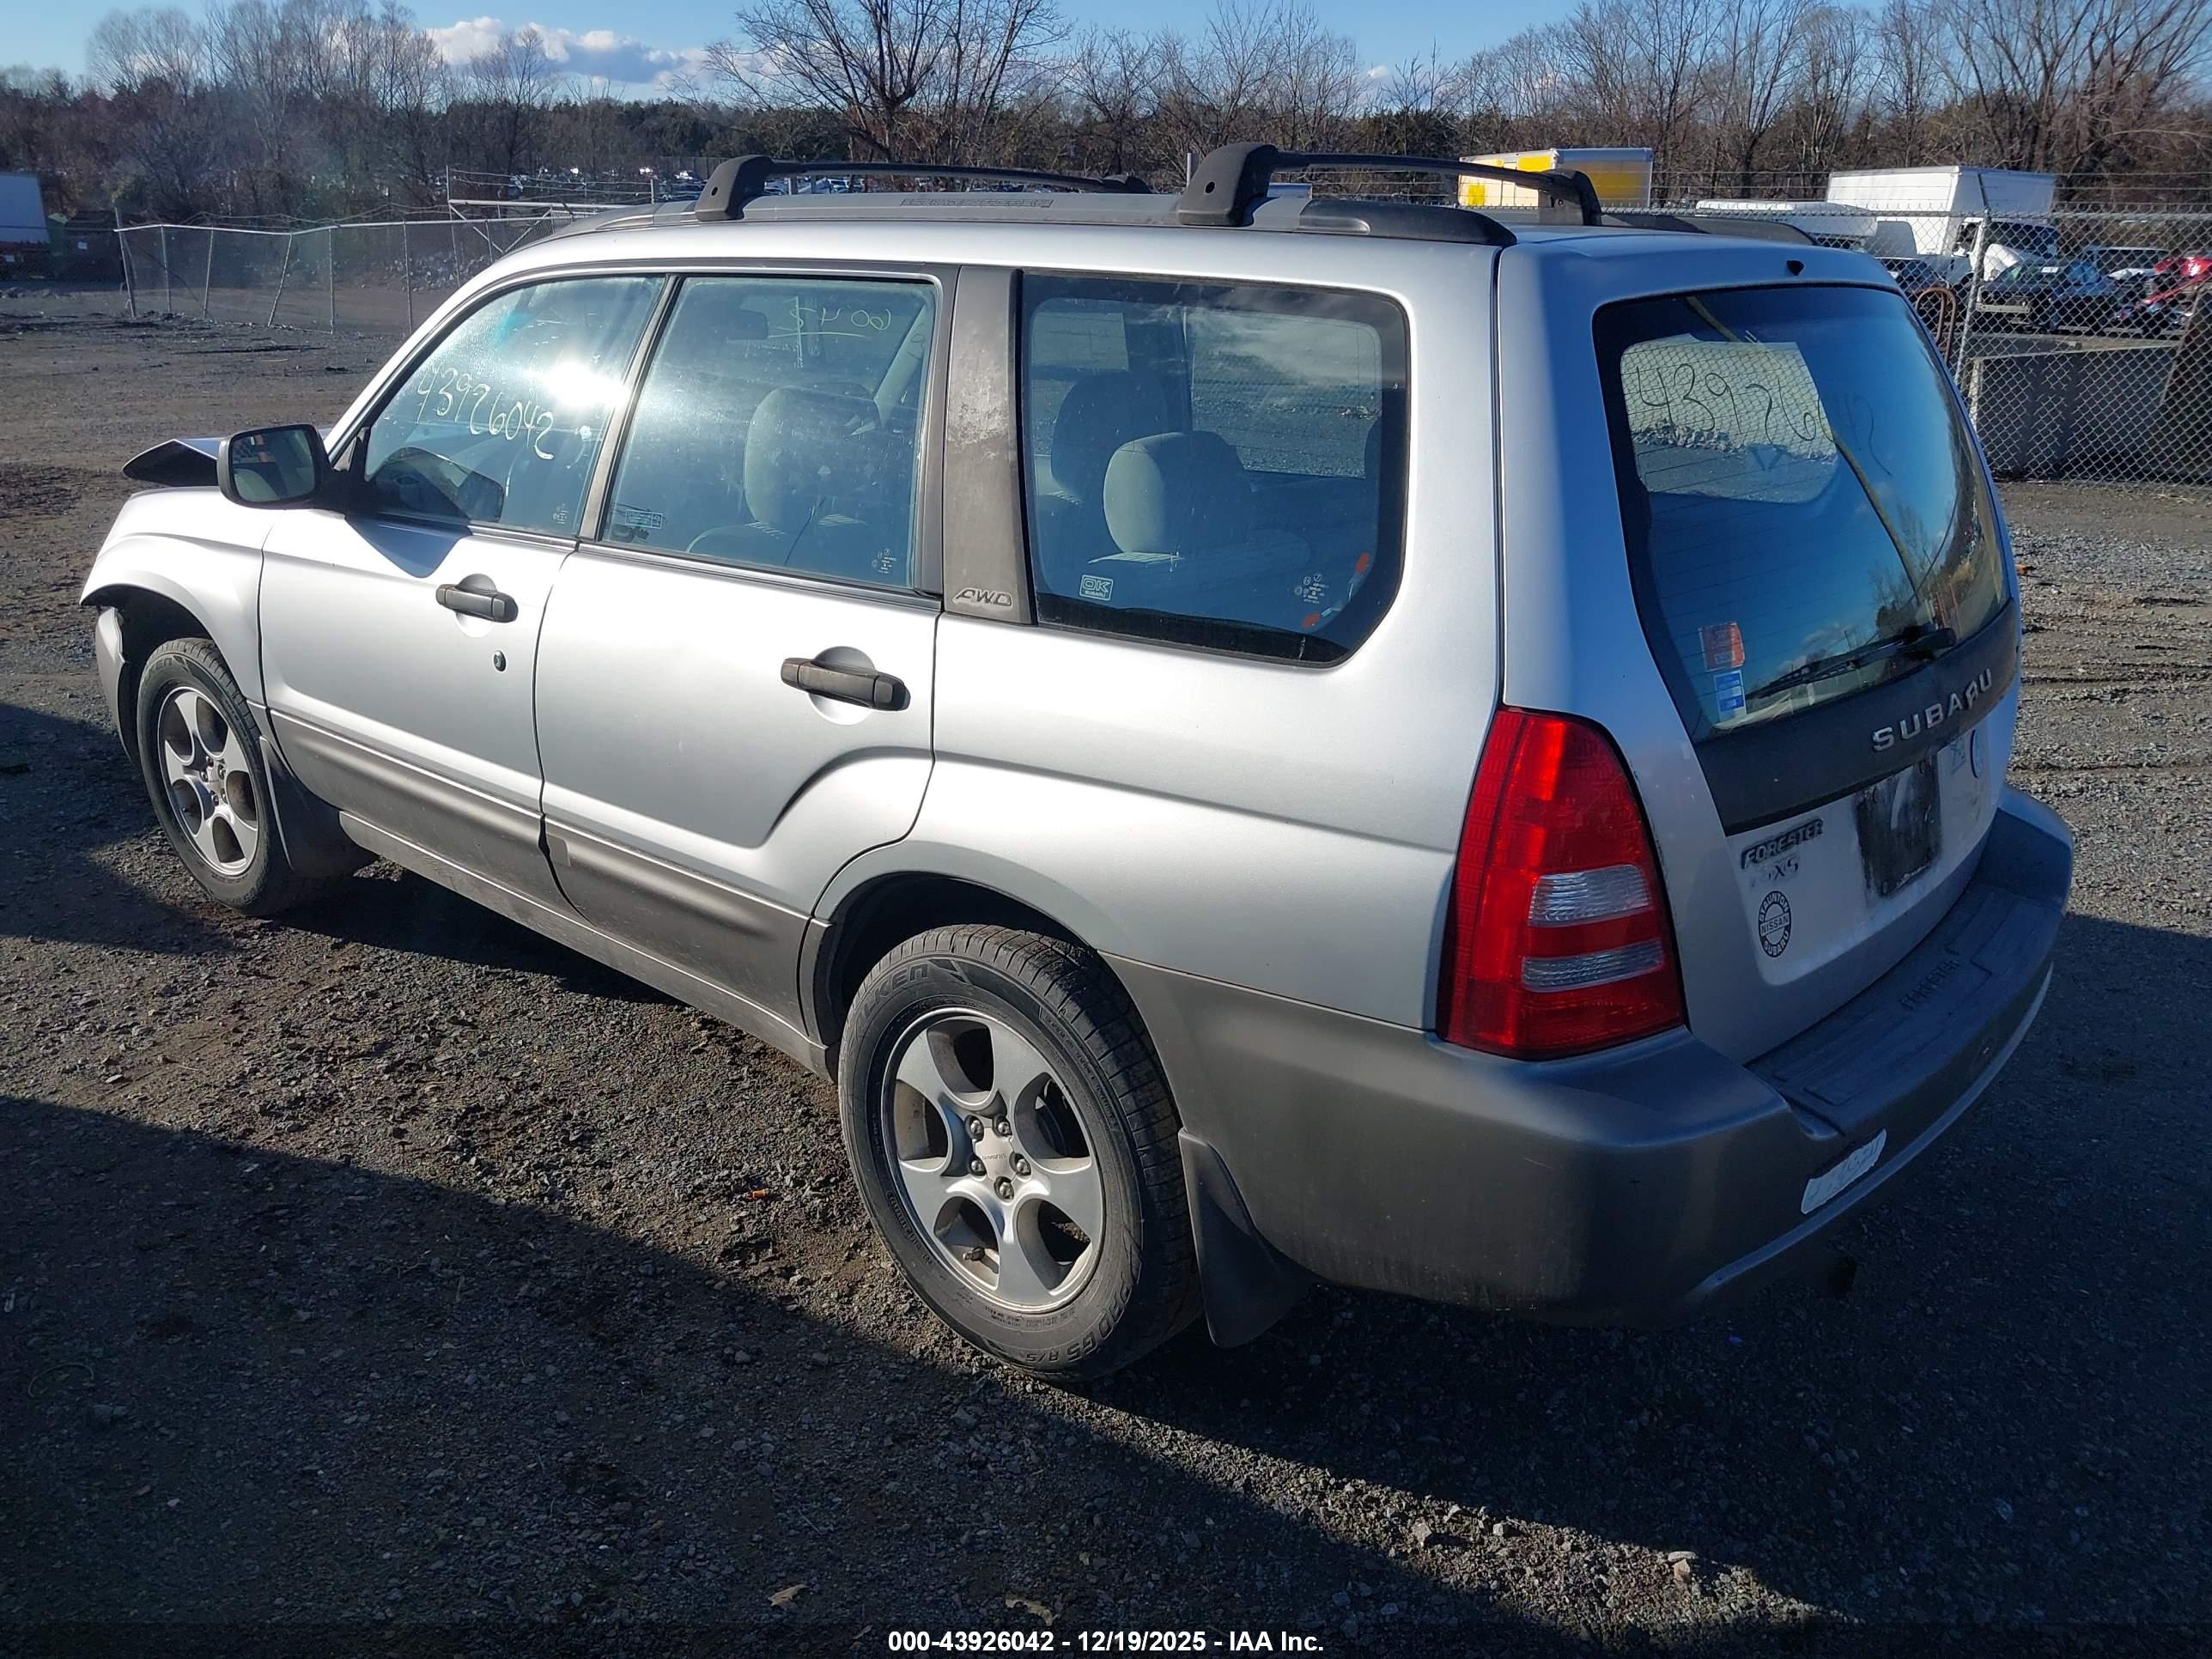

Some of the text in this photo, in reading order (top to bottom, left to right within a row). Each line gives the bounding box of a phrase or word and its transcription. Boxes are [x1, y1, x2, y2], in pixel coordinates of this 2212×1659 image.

[416, 367, 555, 459] 43926042
[954, 588, 1012, 608] AWD
[1082, 577, 1110, 592] OK
[1871, 667, 1993, 753] SUBARU
[1741, 817, 1824, 870] FORESTER
[1759, 892, 1790, 922] STAUNTON
[1760, 915, 1789, 935] NISSAN
[1763, 930, 1790, 956] SUBARU
